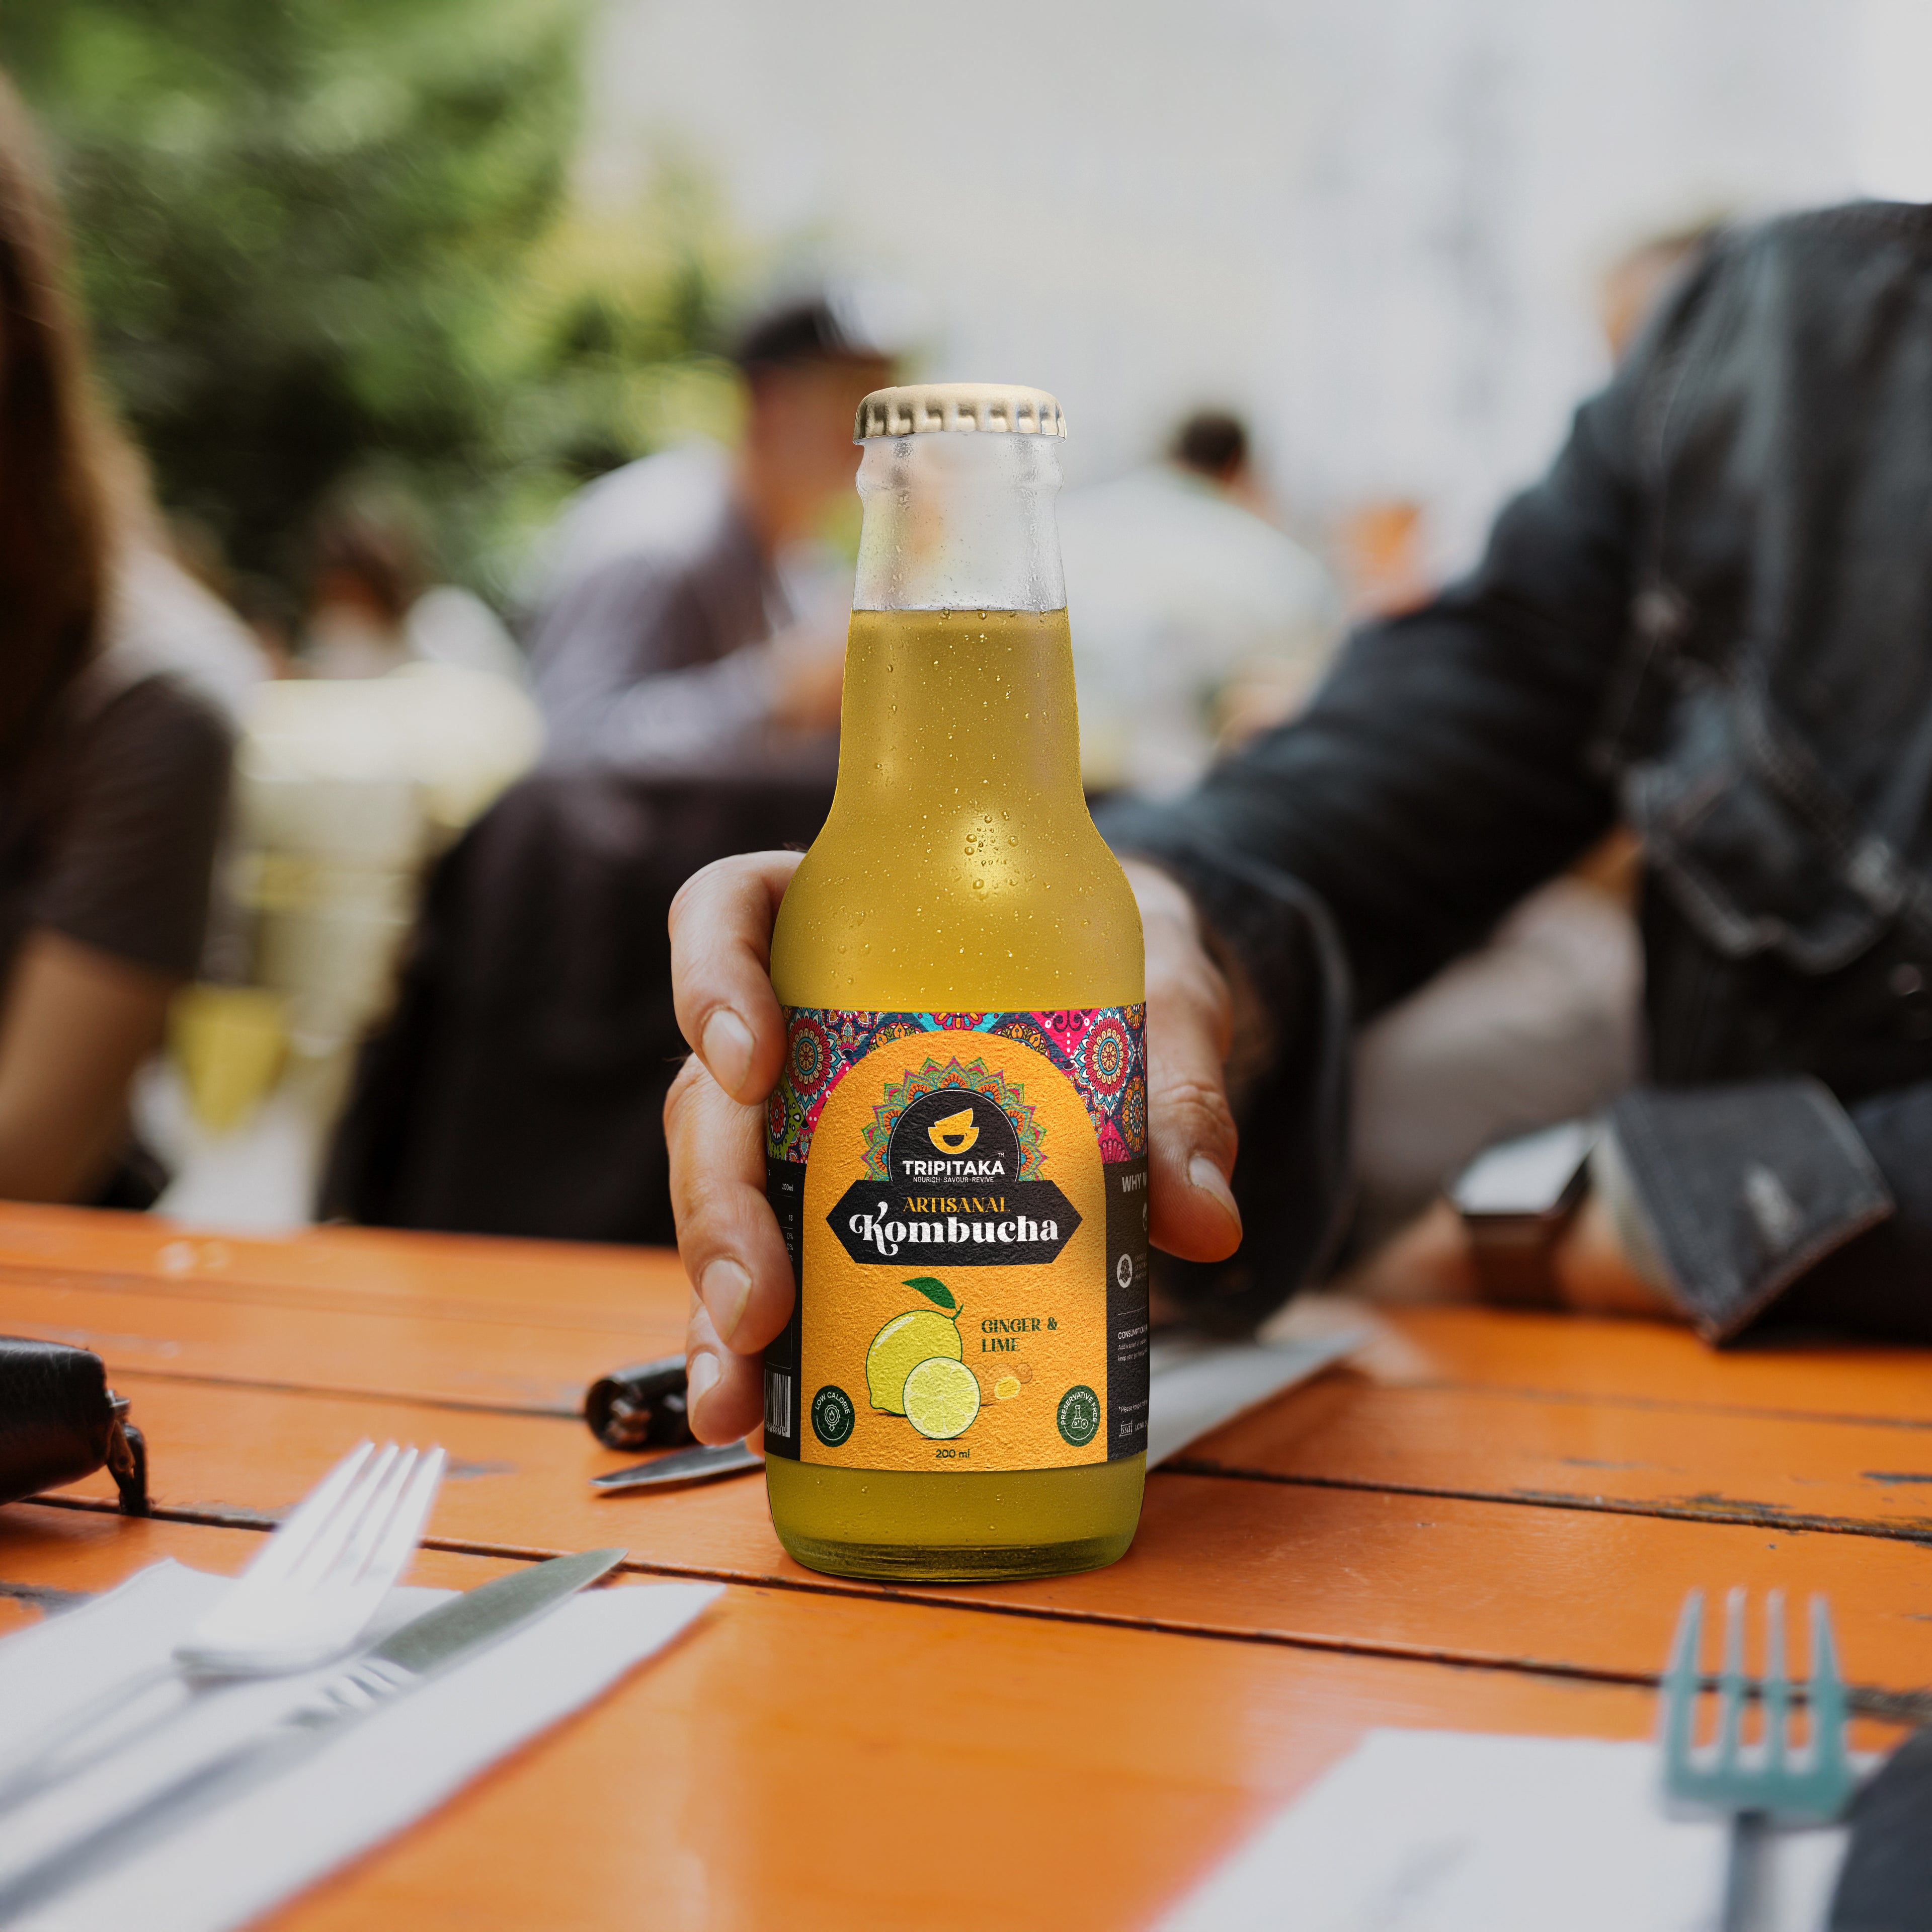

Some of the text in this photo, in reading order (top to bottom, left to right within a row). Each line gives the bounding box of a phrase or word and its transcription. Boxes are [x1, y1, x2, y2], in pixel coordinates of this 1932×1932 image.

[902, 1160, 1005, 1175] TRIPITAKA
[1121, 1173, 1142, 1193] WHY
[903, 1196, 1011, 1213] ARTISANAL
[849, 1201, 1059, 1256] Kombucha
[981, 1317, 1058, 1333] GINGER &
[982, 1337, 1020, 1352] LIME
[815, 1392, 850, 1415] LOW CALORIE
[1061, 1391, 1093, 1425] PRESERVATIVE
[936, 1448, 970, 1458] 200 ml
